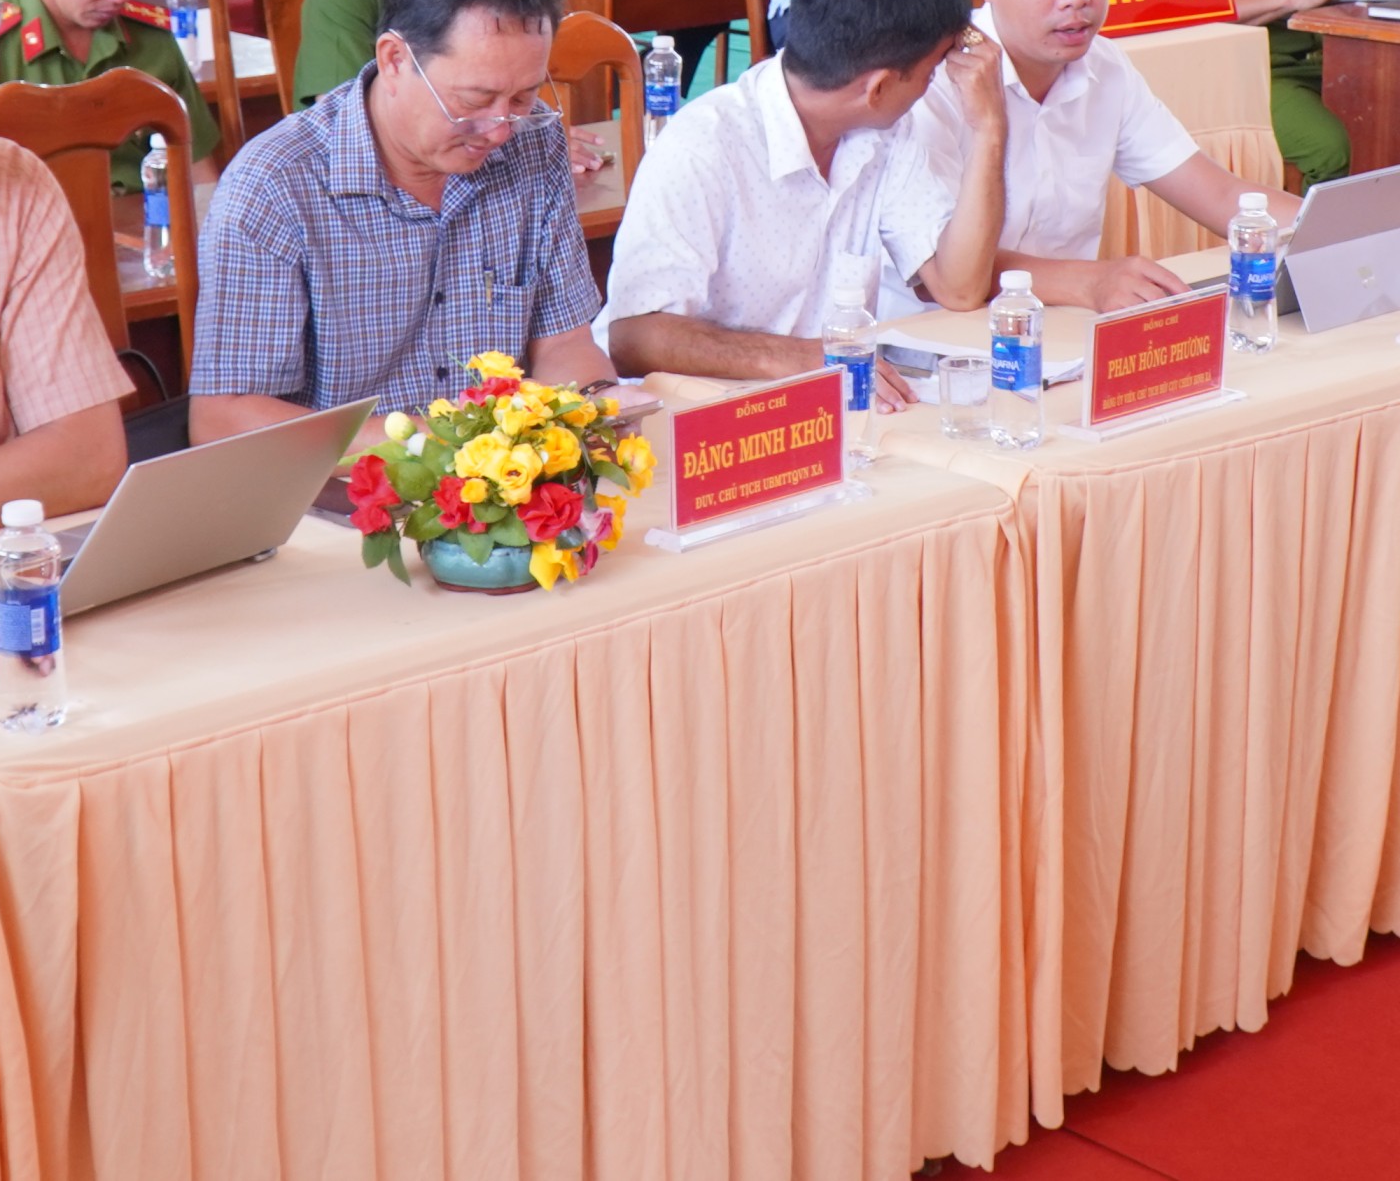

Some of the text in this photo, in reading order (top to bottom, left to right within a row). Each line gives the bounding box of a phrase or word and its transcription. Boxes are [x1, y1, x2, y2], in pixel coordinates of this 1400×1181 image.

[1107, 335, 1210, 380] PHAN HỒNG PHƯƠNG
[736, 394, 787, 419] ĐỒNG CHÍ
[683, 406, 834, 481] ĐẶNG MINH KHỞI
[719, 482, 738, 503] CHỦ
[739, 480, 761, 500] TỊCH
